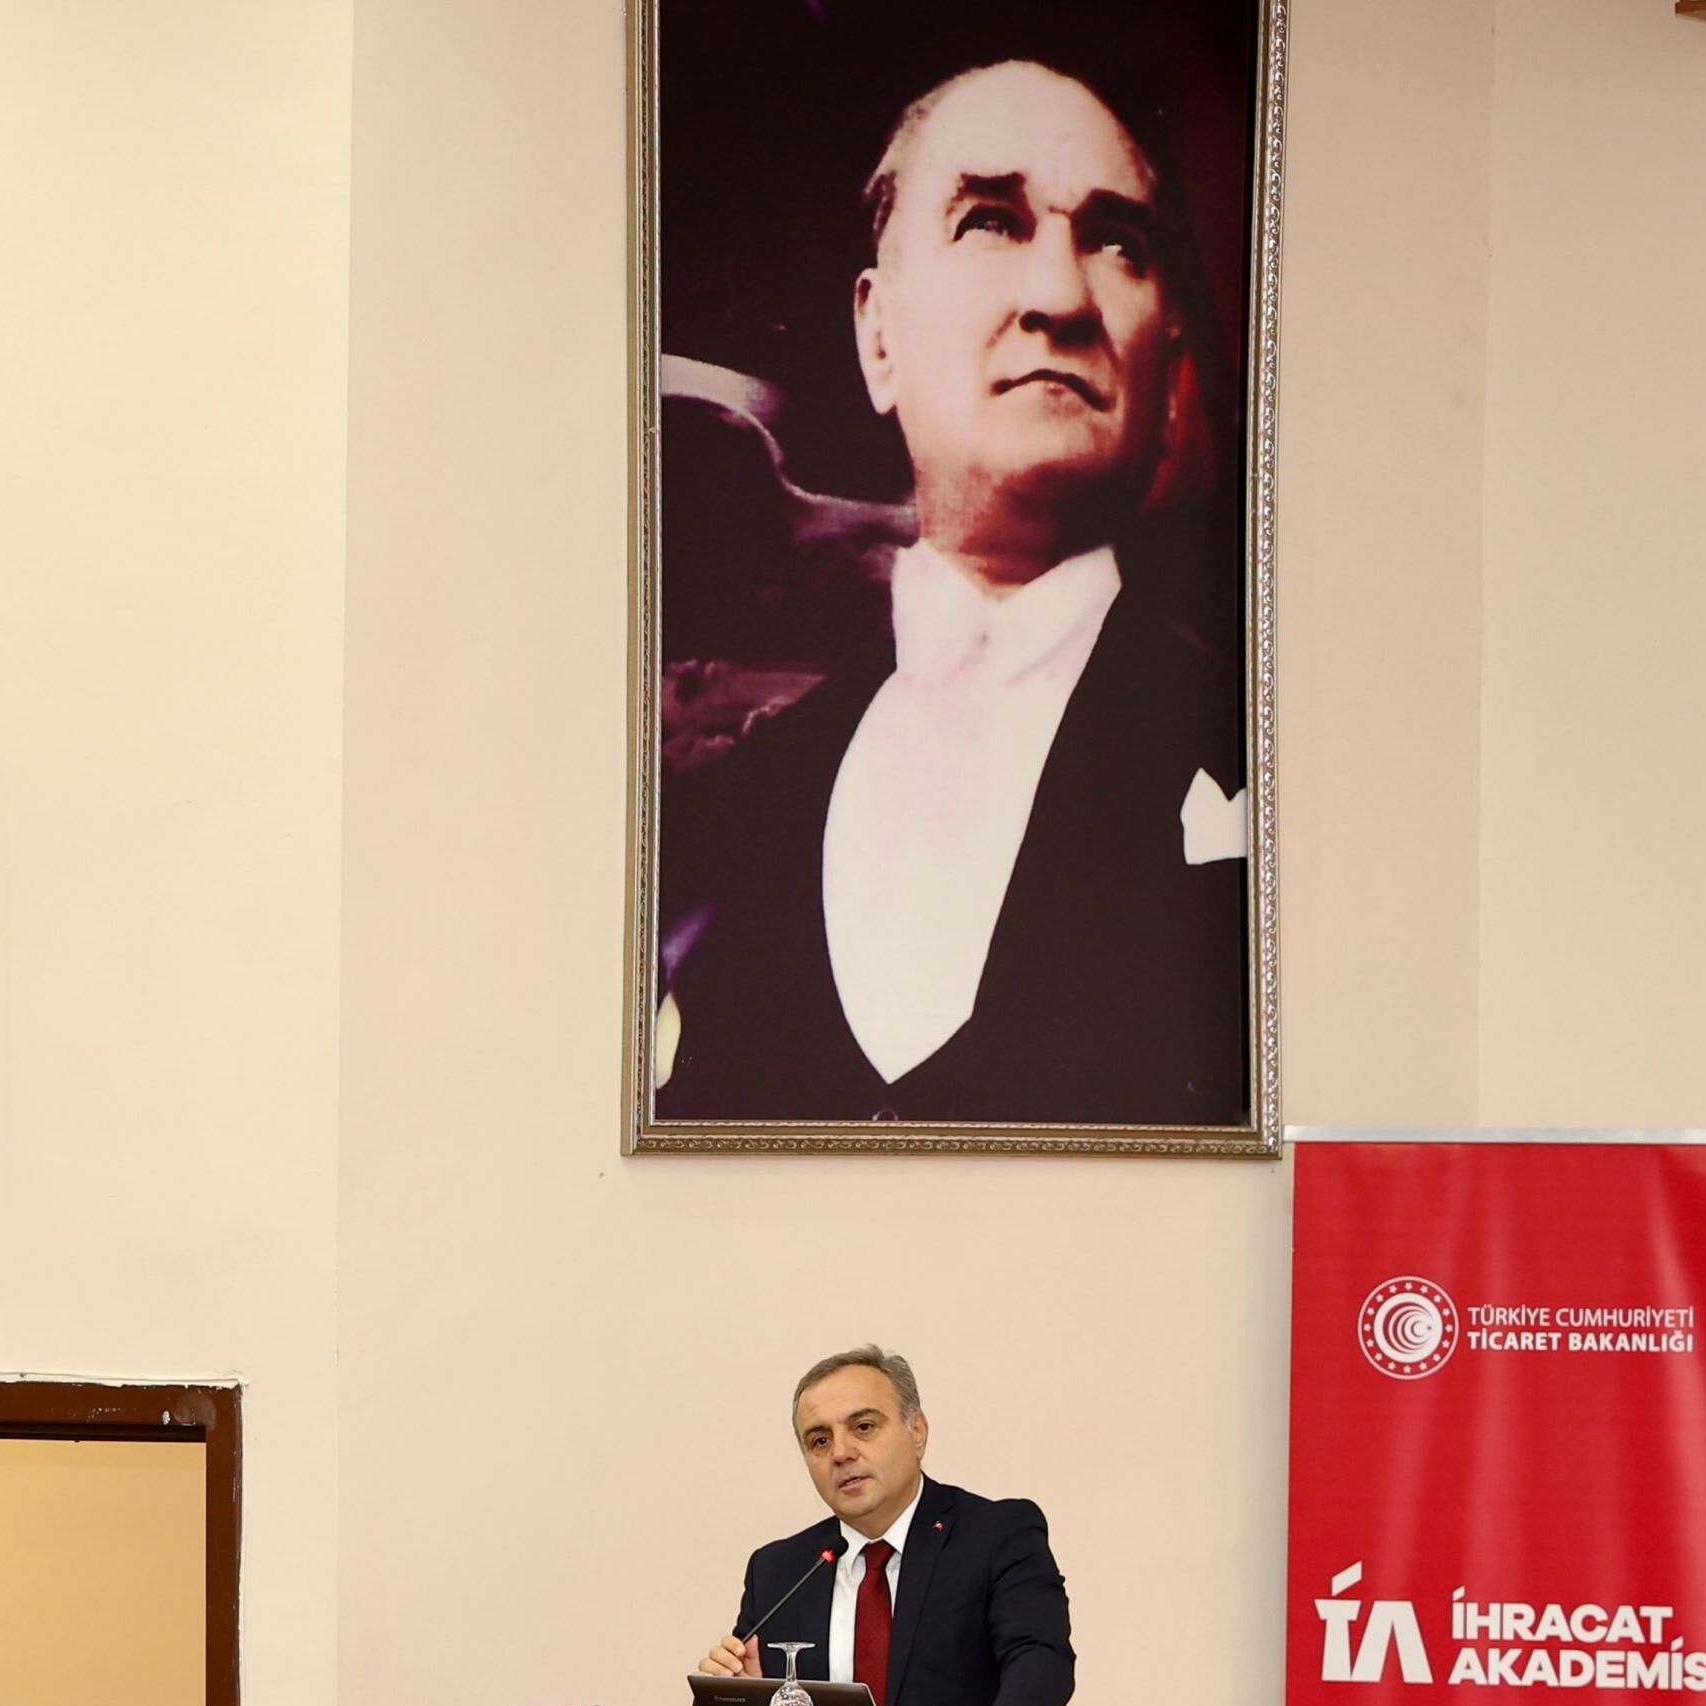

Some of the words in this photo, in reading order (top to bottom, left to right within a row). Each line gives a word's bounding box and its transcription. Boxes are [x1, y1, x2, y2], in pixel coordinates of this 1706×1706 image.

[1467, 1304, 1550, 1326] TÜRKİYE
[1555, 1305, 1694, 1328] CUMHURİYETİ
[1467, 1328, 1561, 1350] TİCARET
[1568, 1330, 1693, 1352] BAKANLIĞI
[1451, 1585, 1674, 1644] İHRACAT
